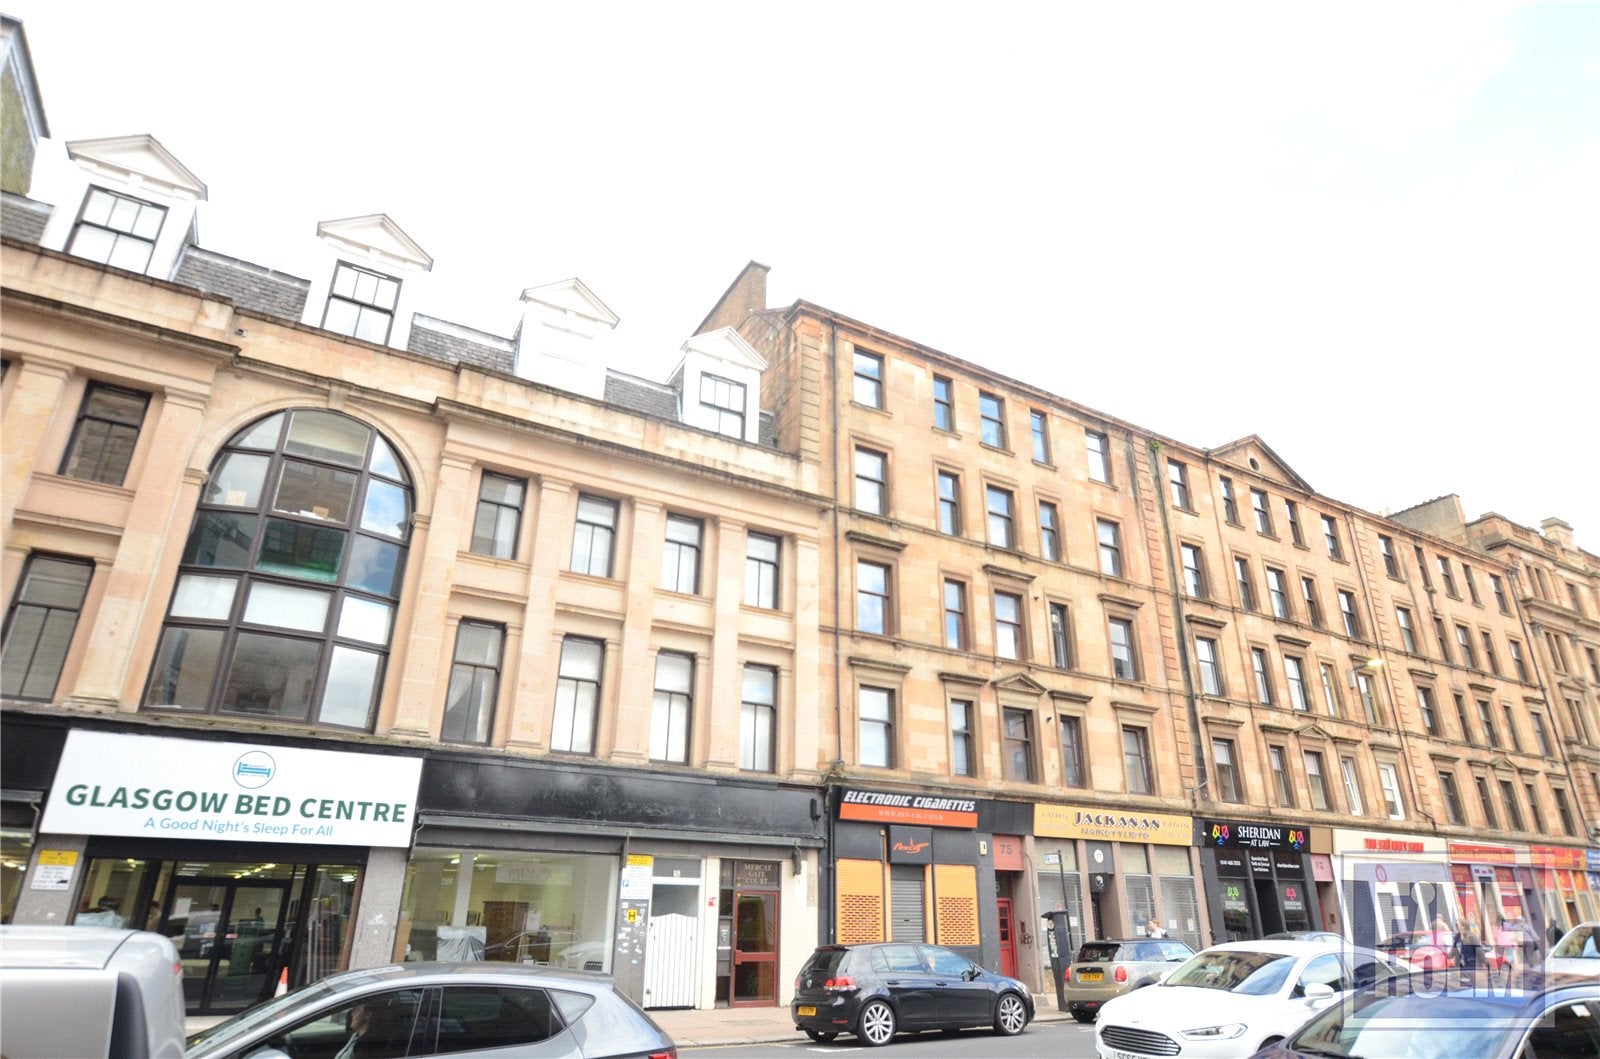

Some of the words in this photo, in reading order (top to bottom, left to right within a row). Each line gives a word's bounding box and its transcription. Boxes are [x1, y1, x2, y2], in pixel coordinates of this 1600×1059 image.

[66, 784, 228, 813] GLASGOW
[235, 794, 291, 817] BED
[300, 798, 407, 823] CENTRE
[844, 790, 912, 807] ELECTRONIC
[913, 796, 976, 812] CIGARETTES
[144, 817, 156, 828] A
[160, 817, 199, 830] Good
[202, 820, 250, 834] Night's
[253, 822, 288, 836] Sleep
[292, 824, 314, 835] For
[316, 825, 333, 836] All
[1074, 811, 1162, 830] JACKANAN
[1238, 826, 1280, 840] SHERIDAN
[1000, 844, 1013, 854] 75
[1250, 839, 1257, 847] AT
[744, 863, 771, 871] MERCAT
[745, 877, 769, 885] COURT
